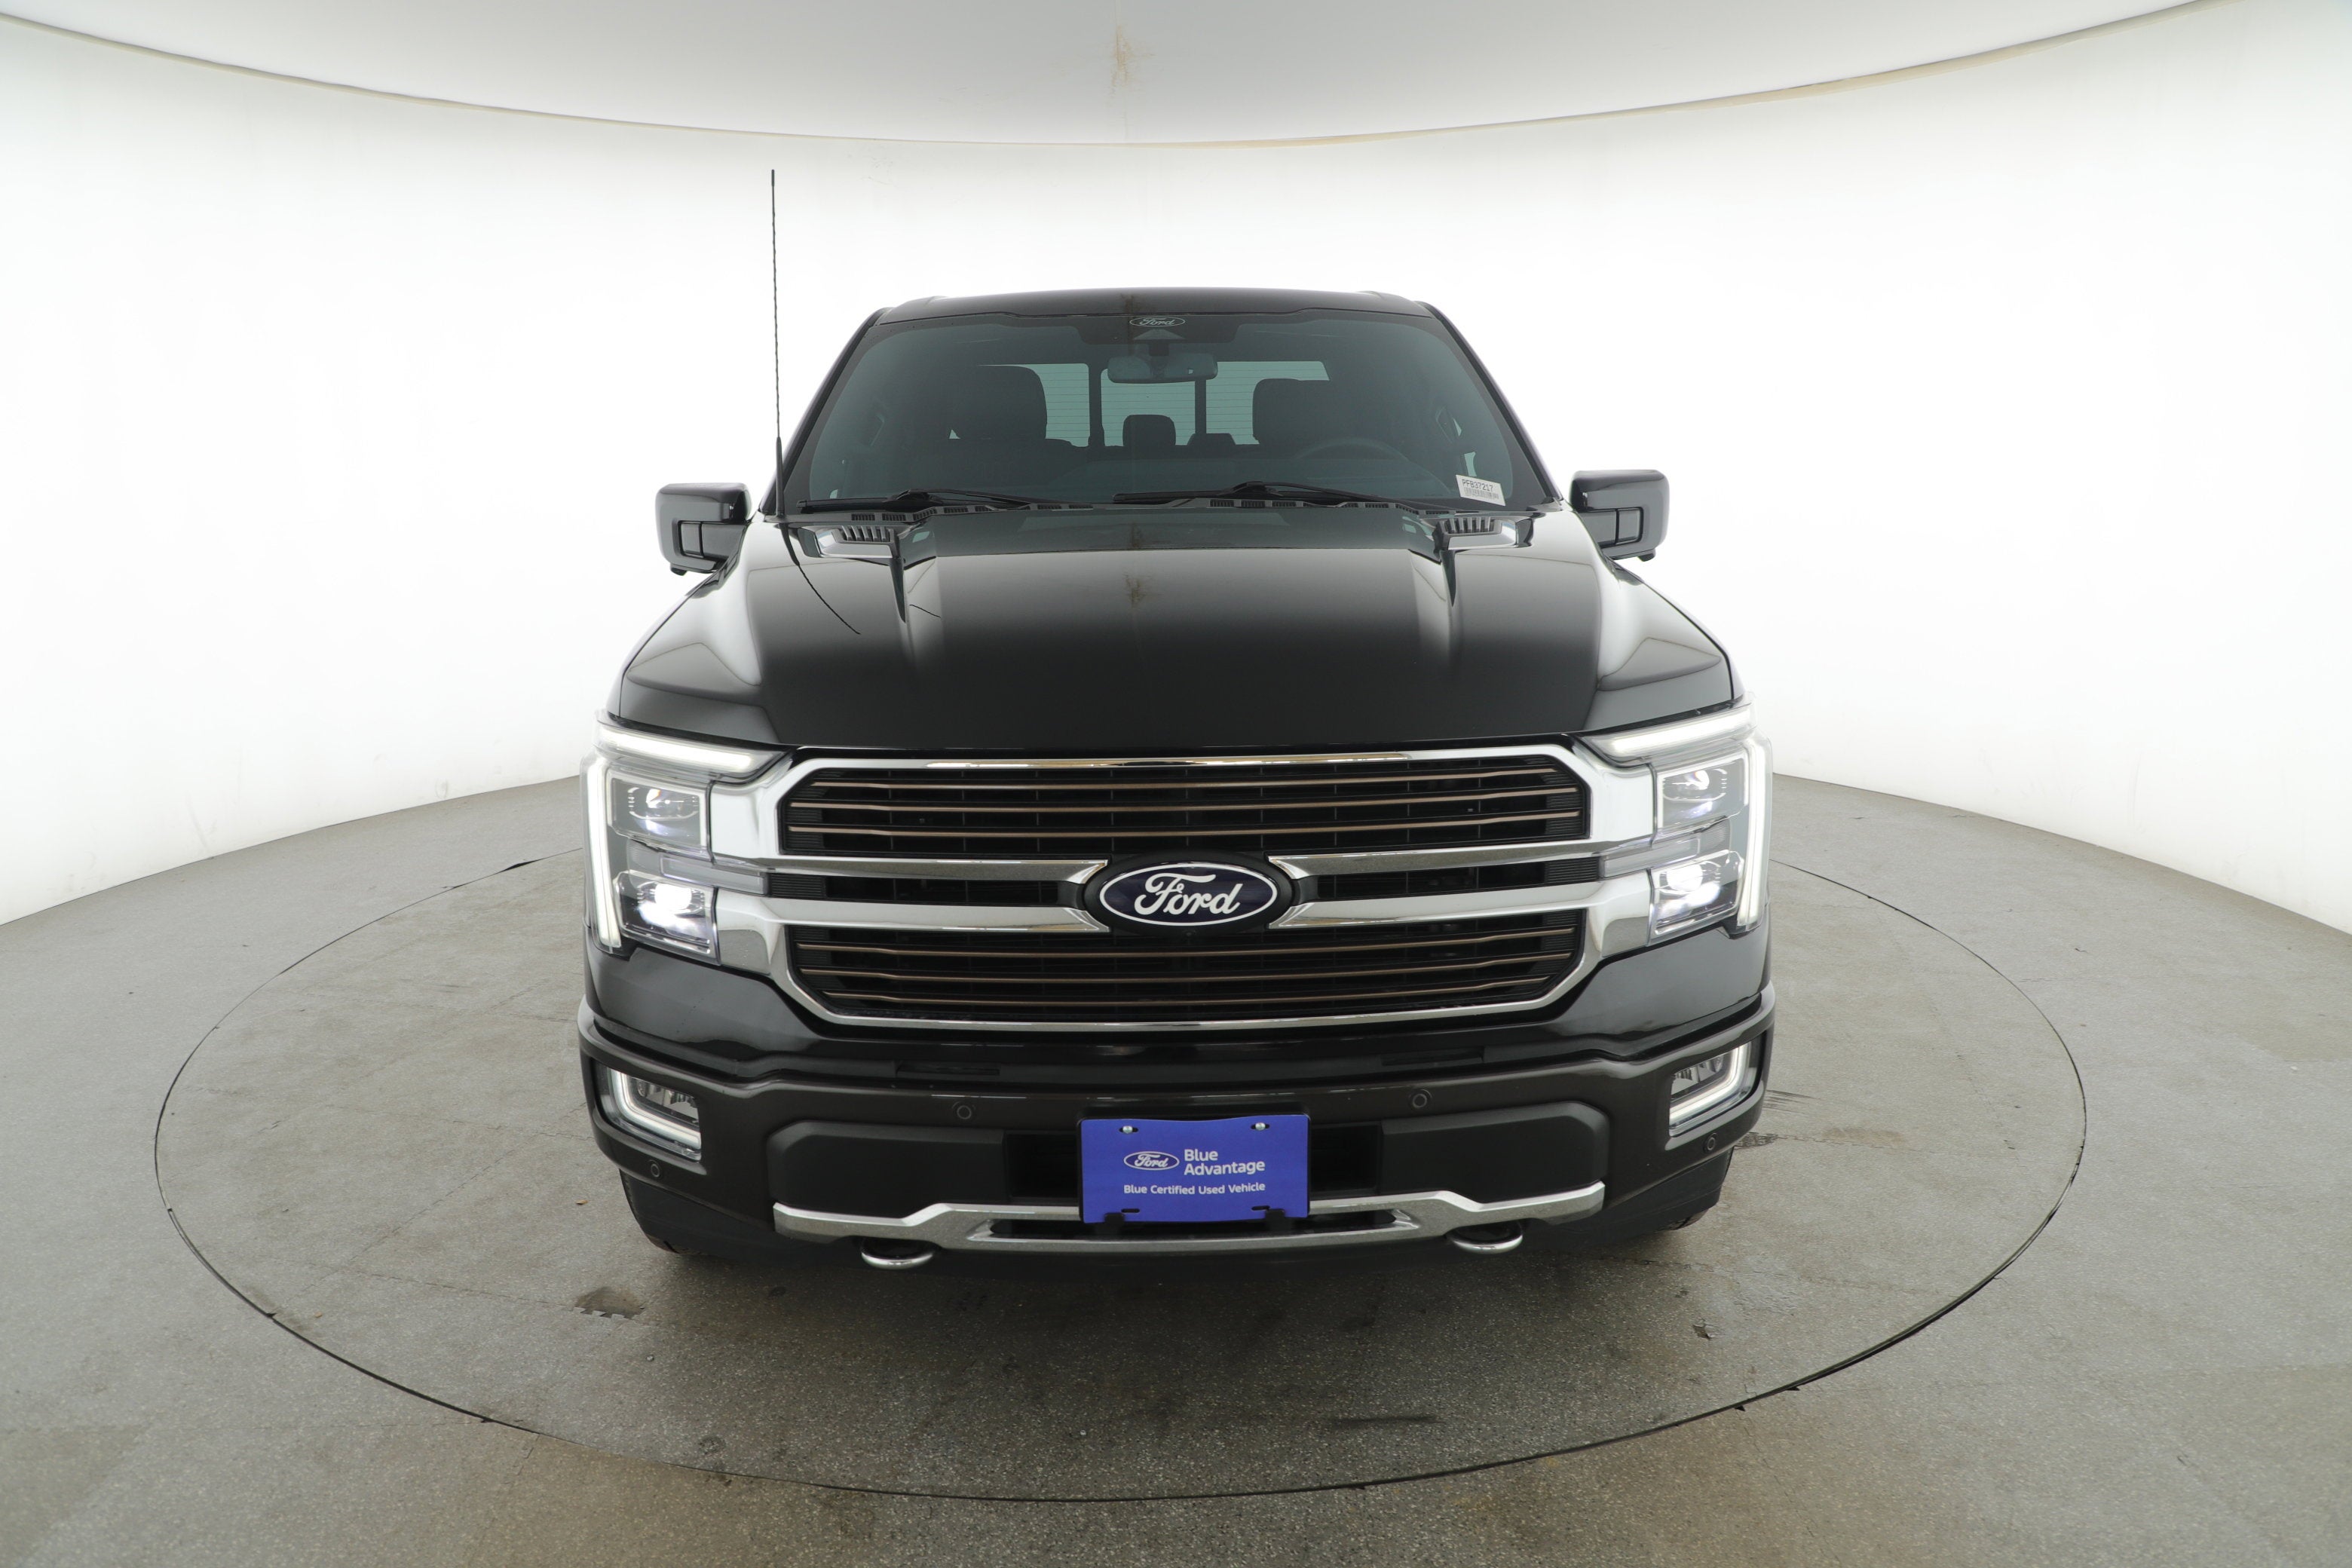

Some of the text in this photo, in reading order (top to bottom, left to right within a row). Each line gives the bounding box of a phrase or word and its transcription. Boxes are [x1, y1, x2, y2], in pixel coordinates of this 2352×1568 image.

[1139, 317, 1175, 326] Ford
[1134, 872, 1243, 915] Ford
[1134, 1153, 1168, 1168] Ford
[1184, 1149, 1218, 1162] Blue
[1184, 1160, 1266, 1175] Advantage
[1123, 1181, 1266, 1195] Blue Certified Used Vehicle
